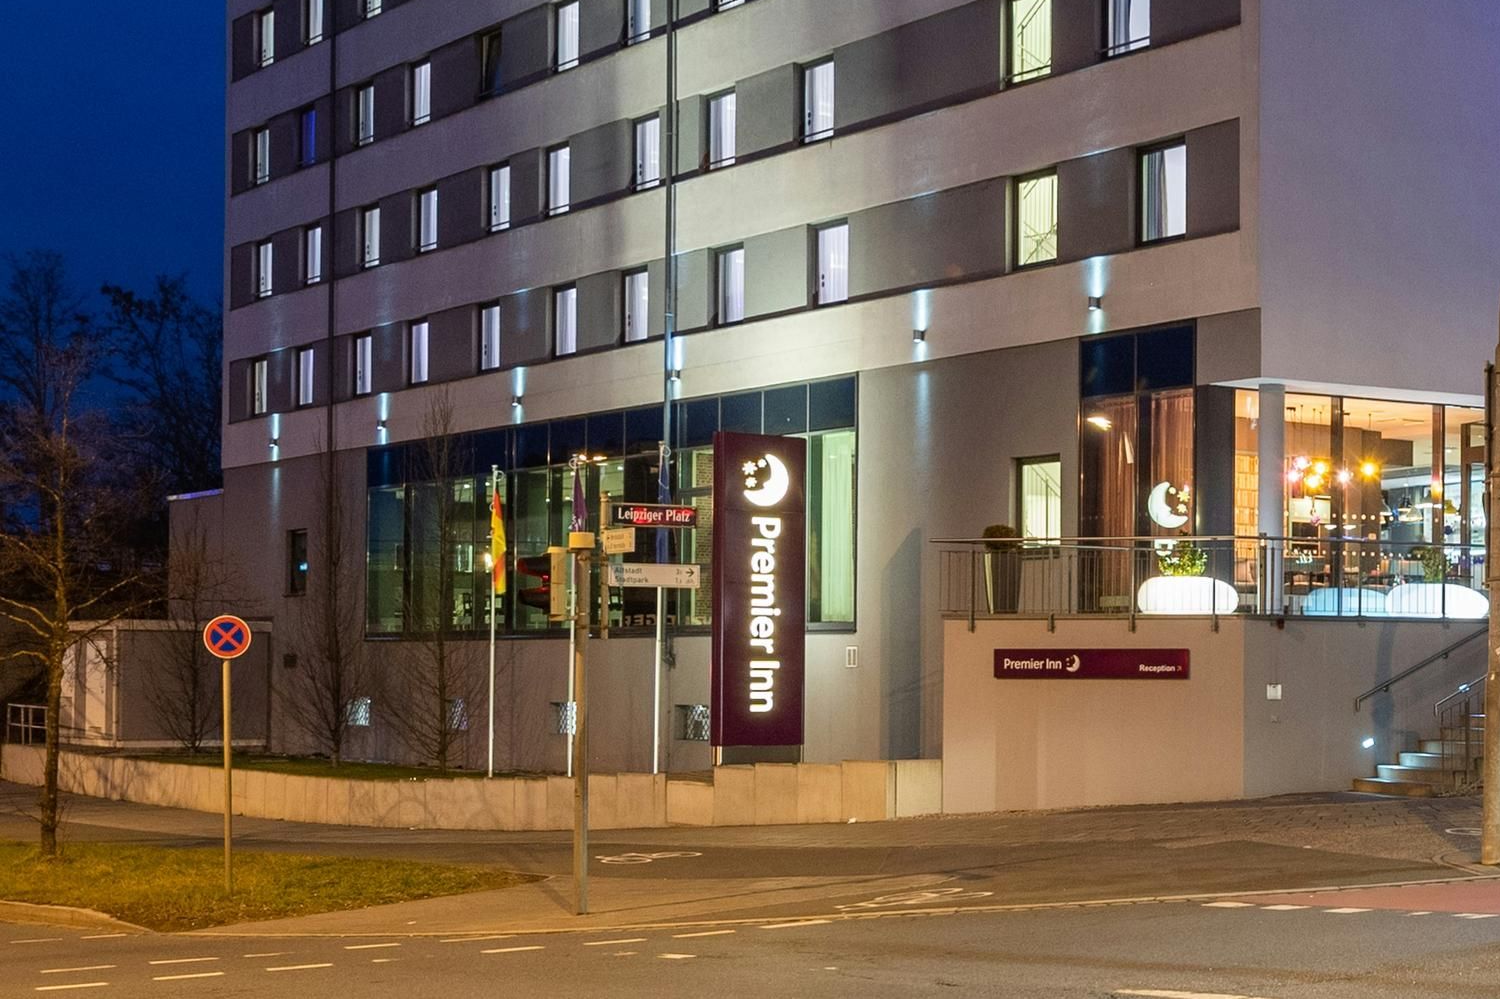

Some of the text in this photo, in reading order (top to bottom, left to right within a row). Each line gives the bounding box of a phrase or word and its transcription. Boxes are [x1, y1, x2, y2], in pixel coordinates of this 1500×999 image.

[618, 506, 691, 524] Leipziger Platz
[749, 516, 782, 713] Premier Inn
[1003, 658, 1062, 670] Premier Inn
[1139, 663, 1176, 673] Reception
